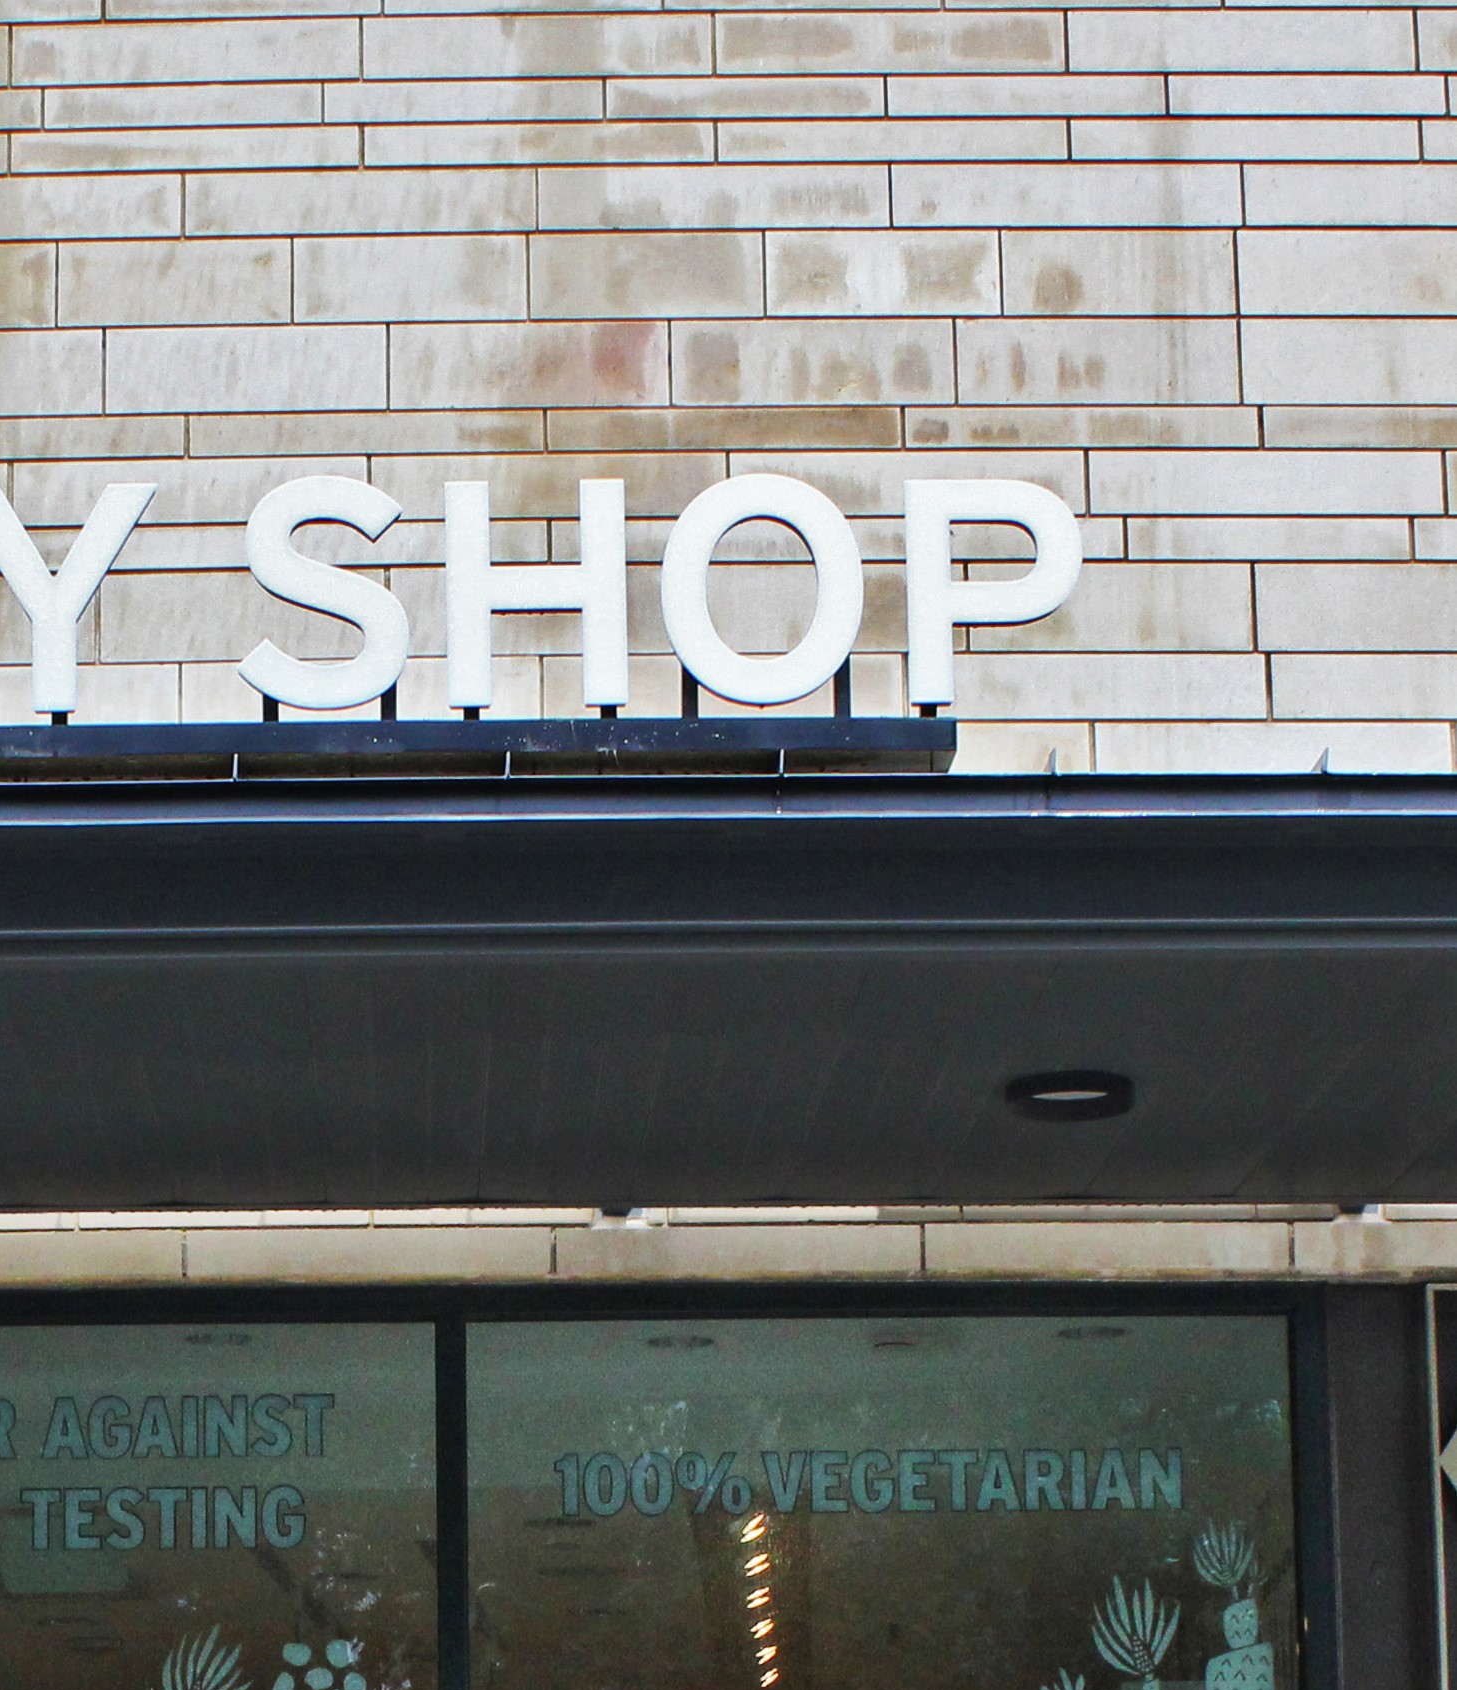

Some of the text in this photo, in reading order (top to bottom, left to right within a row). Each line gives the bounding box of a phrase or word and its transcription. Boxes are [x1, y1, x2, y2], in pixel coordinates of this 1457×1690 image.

[236, 473, 1084, 712] SHOP
[43, 1393, 335, 1460] AGAINST
[553, 1447, 1183, 1518] 100% VEGETARIAN
[19, 1484, 308, 1551] TESTING
